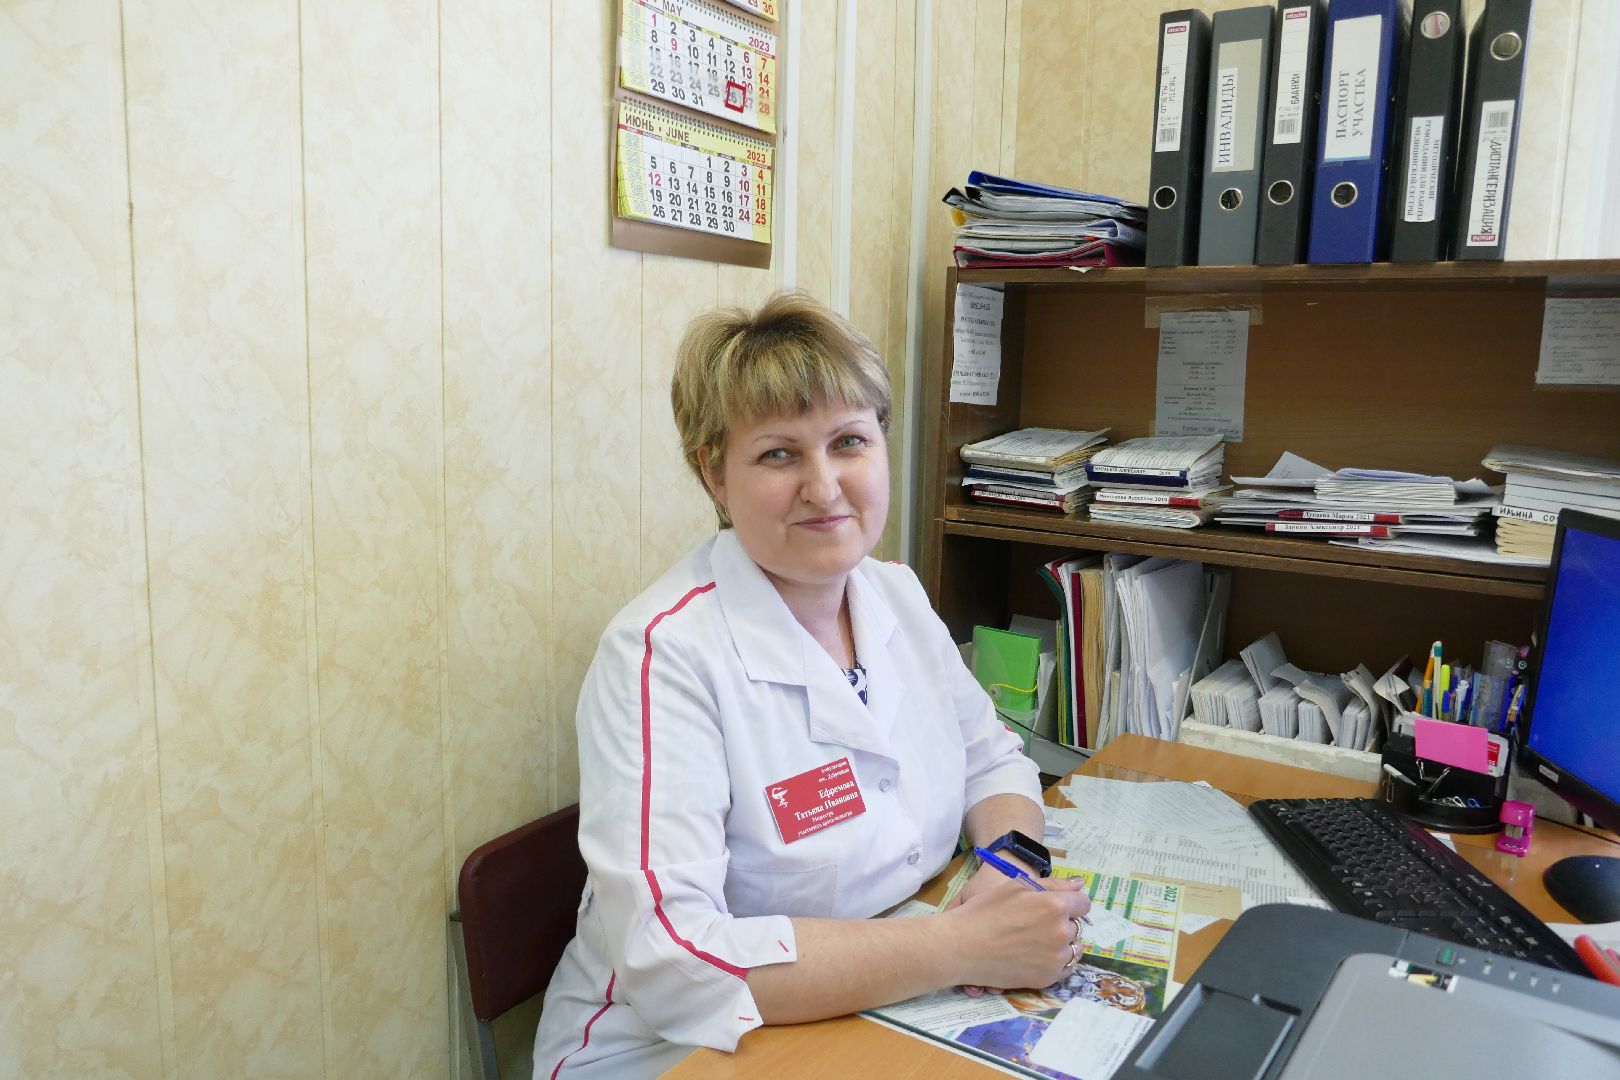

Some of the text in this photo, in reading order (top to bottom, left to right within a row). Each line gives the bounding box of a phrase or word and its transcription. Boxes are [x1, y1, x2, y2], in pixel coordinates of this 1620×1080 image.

[662, 0, 682, 17] MAY
[762, 1, 774, 15] 30
[651, 13, 657, 27] 1
[670, 22, 677, 35] 2
[690, 30, 696, 43] 3
[708, 38, 715, 50] 4
[726, 44, 733, 57] 5
[743, 51, 750, 64] 6
[761, 58, 767, 70] 7
[748, 36, 770, 52] 2023
[651, 30, 658, 43] 8
[671, 38, 677, 51] 9
[688, 44, 699, 60] 10
[707, 52, 717, 67] 11
[724, 59, 735, 74] 12
[742, 66, 752, 80] 13
[759, 72, 769, 86] 14
[688, 61, 699, 75] 17
[650, 62, 664, 79] 22
[670, 71, 683, 85] 23
[689, 77, 701, 92] 24
[708, 84, 720, 98] 25
[759, 102, 769, 115] 28
[651, 79, 665, 94] 29
[672, 86, 685, 100] 30
[692, 92, 704, 107] 31
[1291, 73, 1300, 105] БЛАНКИ
[1352, 68, 1367, 139] УЧАСТКА
[1219, 74, 1235, 164] ИНВАЛИДЫ
[1335, 70, 1350, 139] ПАСПОРТ
[625, 113, 654, 131] ИЮНЬ
[666, 127, 690, 143] JUNE
[707, 156, 712, 168] 1
[724, 160, 730, 173] 2
[742, 165, 748, 177] 3
[758, 169, 764, 181] 4
[747, 150, 766, 164] 2023
[1407, 126, 1421, 216] МЕДИЦИНСКОЙ СЕСТРЫ
[1428, 139, 1440, 200] МЕТОДИЧЕСКИЕ
[650, 156, 657, 169] 5
[670, 161, 677, 174] 6
[688, 166, 694, 178] 7
[706, 171, 713, 184] 8
[724, 176, 730, 187] 9
[739, 180, 750, 192] 10
[757, 184, 766, 196] 11
[1481, 140, 1502, 234] ДИСПАНСЕРИЗАЦИЯ
[648, 172, 661, 187] 12
[668, 176, 680, 191] 13
[687, 181, 698, 195] 14
[704, 186, 716, 199] 15
[721, 190, 733, 203] 16
[739, 195, 750, 207] 17
[756, 199, 766, 211] 18
[650, 188, 662, 202] 19
[669, 193, 682, 206] 20
[688, 198, 699, 211] 21
[705, 202, 717, 215] 22
[721, 206, 734, 218] 23
[738, 209, 750, 222] 24
[755, 213, 766, 225] 25
[1416, 190, 1425, 221] РАБОТЫ
[652, 204, 665, 218] 26
[671, 209, 683, 223] 27
[689, 213, 701, 226] 28
[706, 217, 718, 229] 29
[723, 220, 735, 232] 30
[1500, 507, 1559, 523] ИЛЬИНА СО
[818, 780, 855, 799] Ефремова
[795, 791, 859, 821] Татьяна Ивановна
[1164, 886, 1178, 902] 2022
